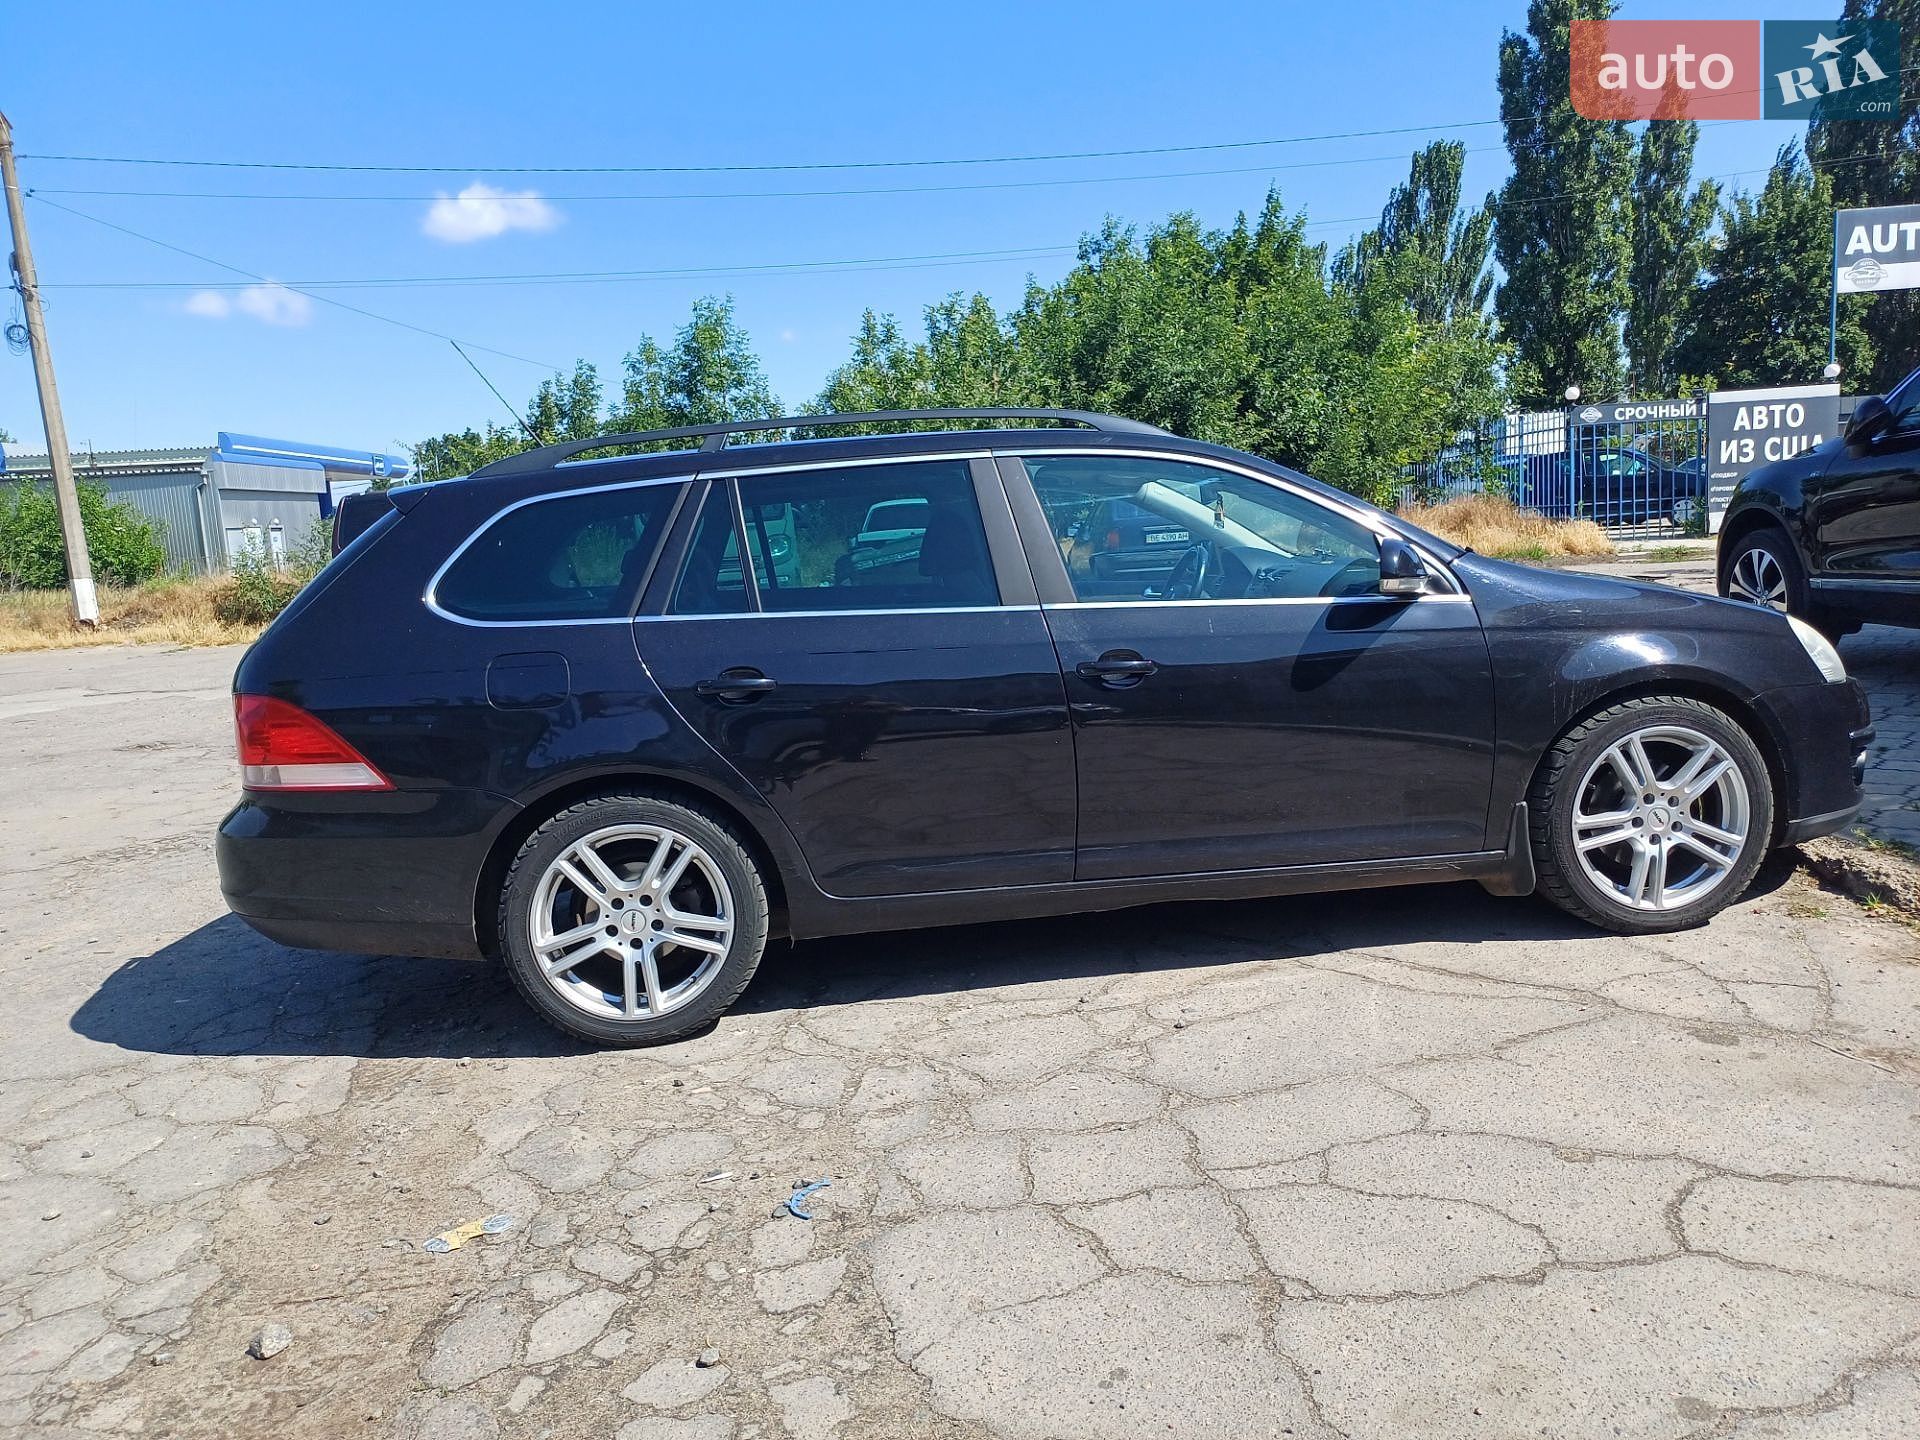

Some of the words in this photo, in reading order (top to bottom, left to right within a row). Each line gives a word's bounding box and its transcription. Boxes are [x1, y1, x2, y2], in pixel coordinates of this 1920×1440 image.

[1614, 400, 1697, 420] СРОЧНЫЙ
[1733, 403, 1805, 431] АВТО
[1720, 438, 1755, 464] ИЗ
